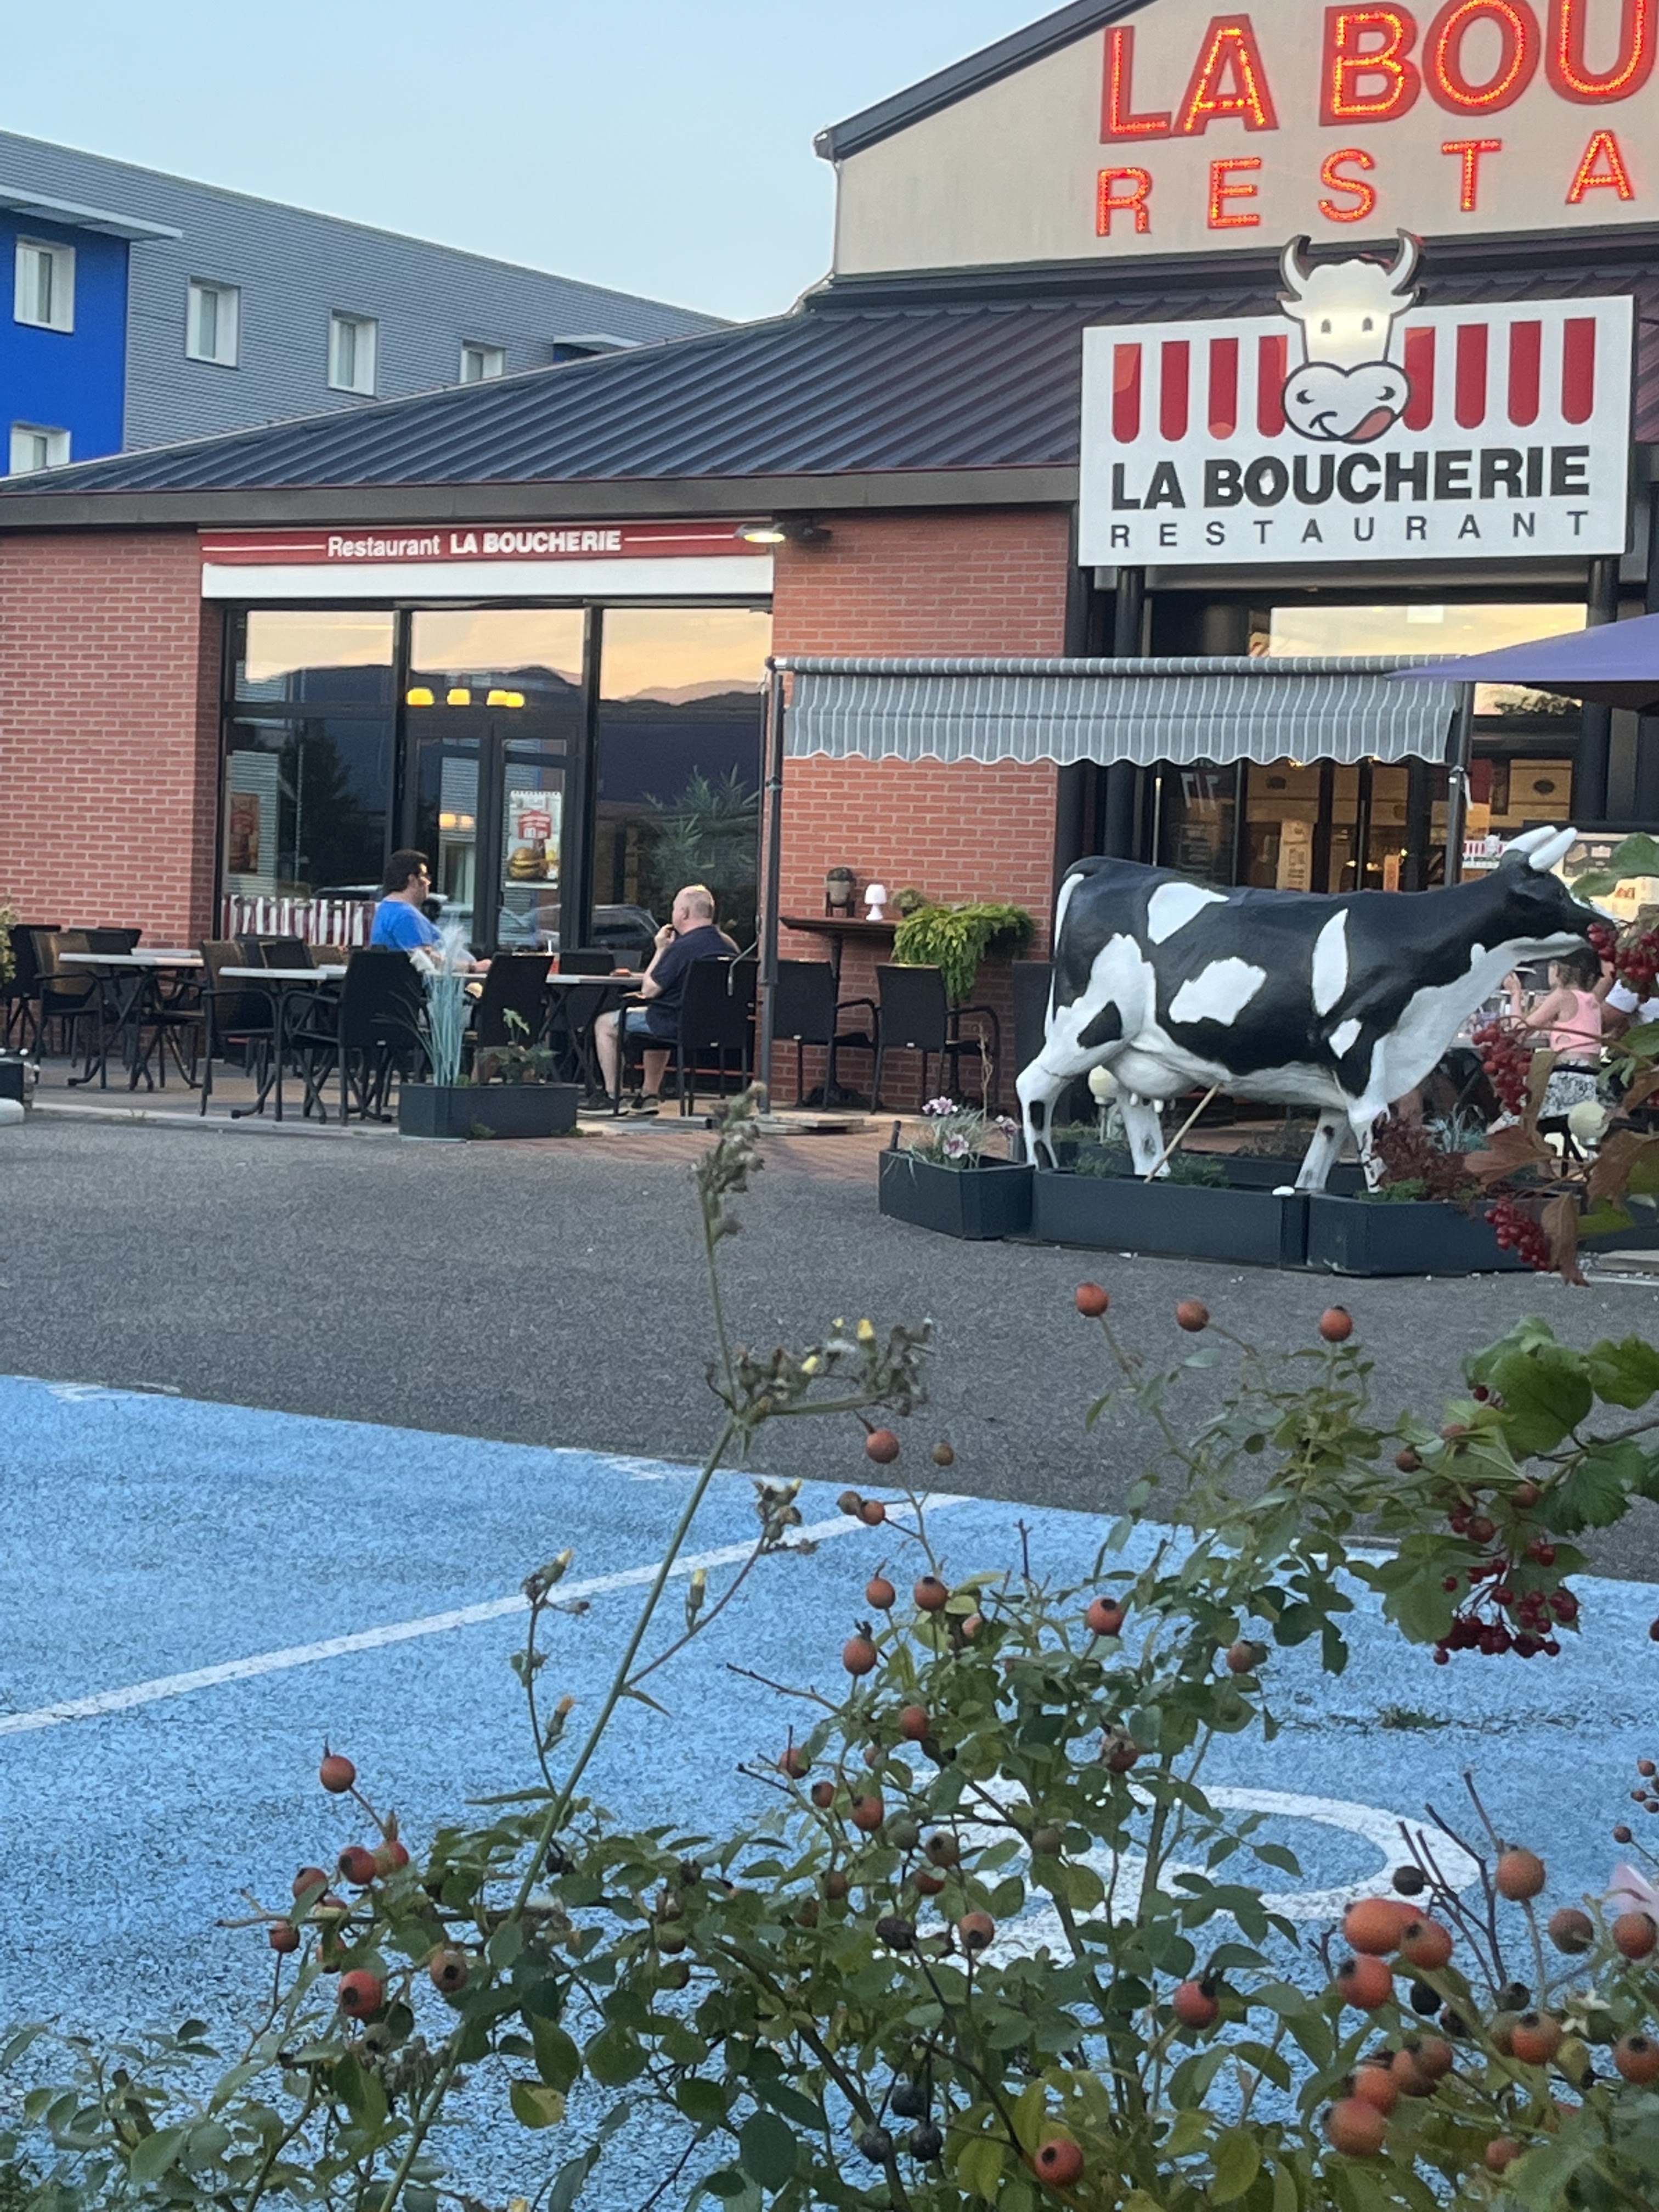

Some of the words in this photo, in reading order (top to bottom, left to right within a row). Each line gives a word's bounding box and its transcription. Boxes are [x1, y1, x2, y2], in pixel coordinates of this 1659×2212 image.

[1099, 14, 1279, 144] LA
[1319, 0, 1657, 127] BOU
[1096, 129, 1635, 236] RESTA
[1111, 460, 1186, 511] LA
[1203, 444, 1590, 508] BOUCHERIE
[328, 535, 441, 557] Restaurant
[450, 533, 478, 554] LA
[483, 530, 622, 554] BOUCHERIE
[1110, 510, 1589, 548] RESTAURANT
